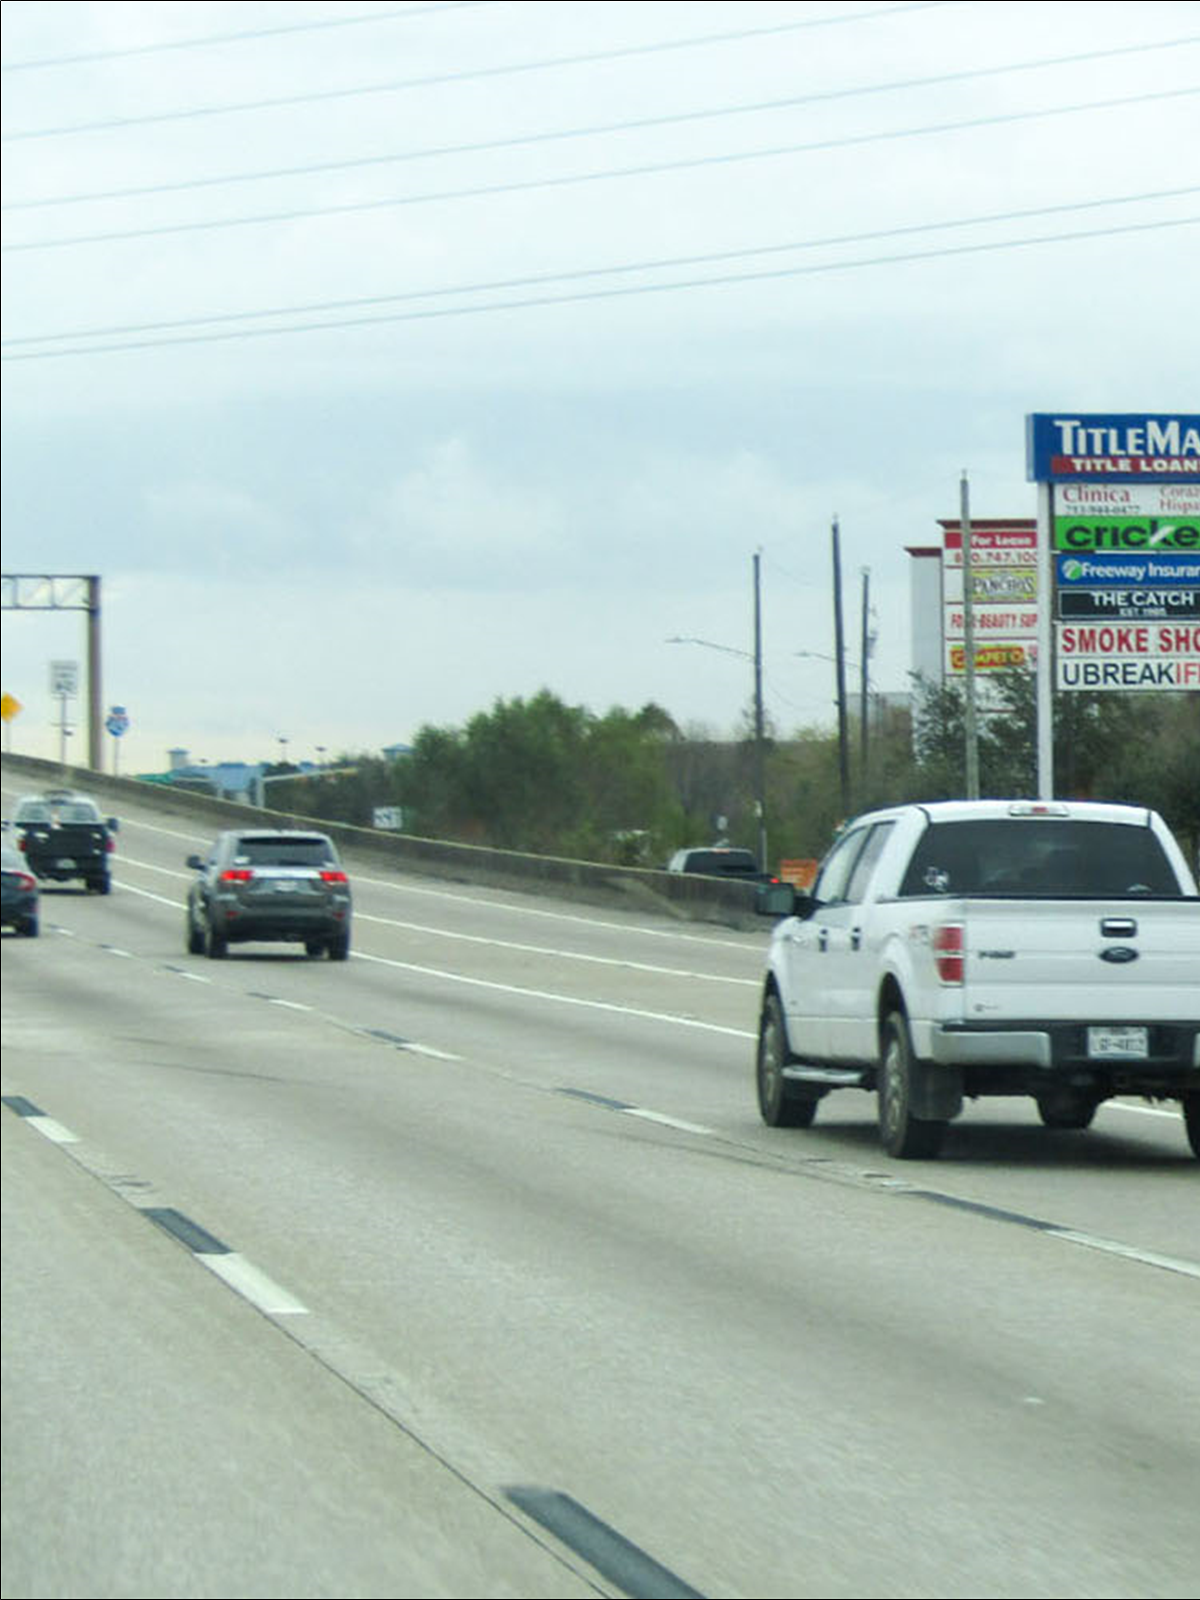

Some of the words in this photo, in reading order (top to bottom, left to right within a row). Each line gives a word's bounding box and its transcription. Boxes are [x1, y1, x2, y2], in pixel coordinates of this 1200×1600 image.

[1071, 458, 1131, 472] TITLE
[1062, 484, 1131, 503] Clinica
[1081, 562, 1146, 580] Freeway
[1090, 591, 1129, 606] THE
[1132, 591, 1194, 606] CATCH
[1062, 628, 1148, 652] SMOKE
